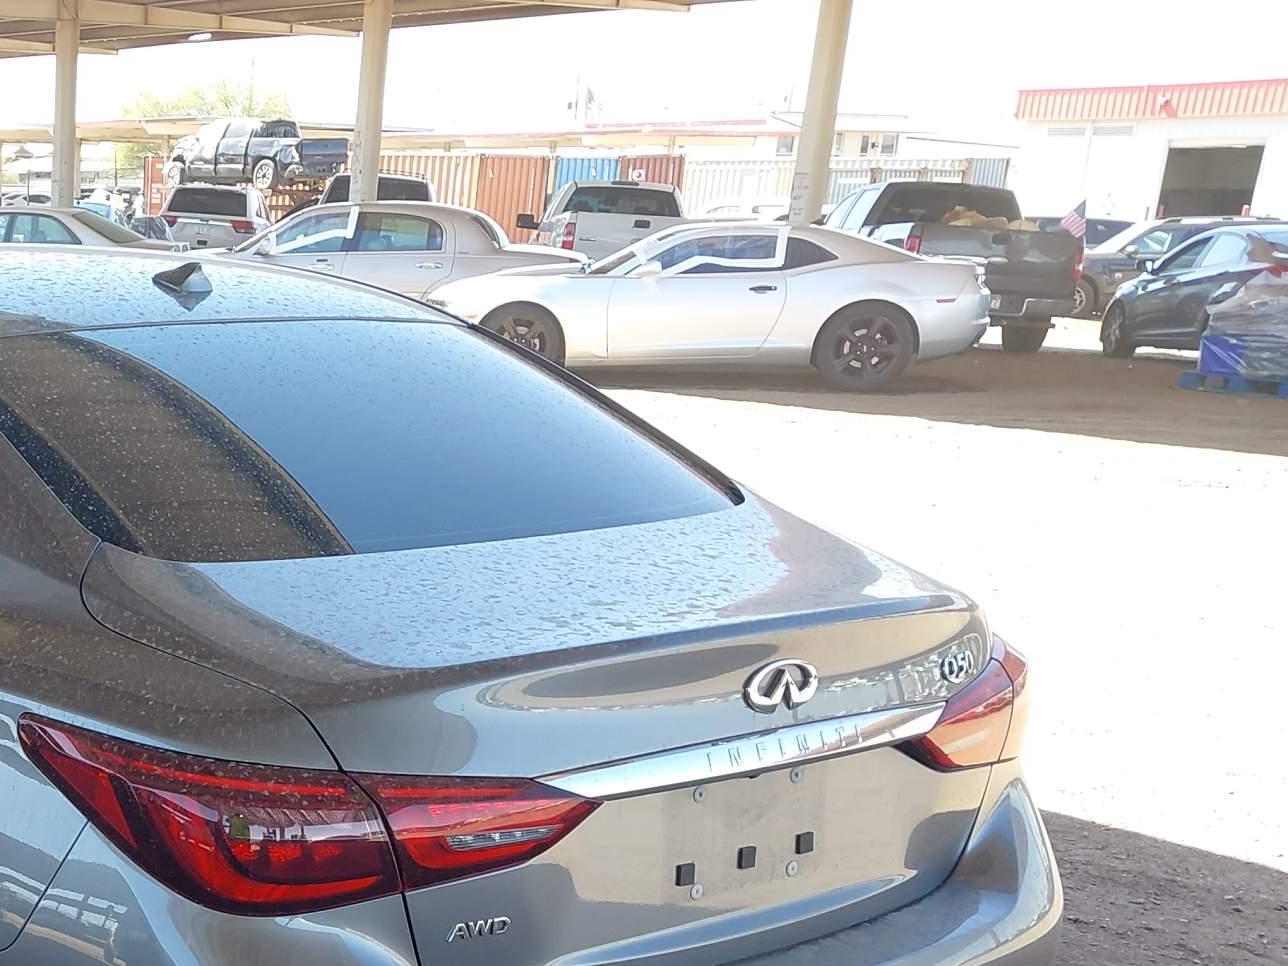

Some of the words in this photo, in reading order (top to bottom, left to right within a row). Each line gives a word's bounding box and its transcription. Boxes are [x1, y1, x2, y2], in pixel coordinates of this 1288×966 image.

[941, 650, 974, 684] Q50
[706, 723, 861, 772] INFINITI
[446, 916, 511, 943] AWD
